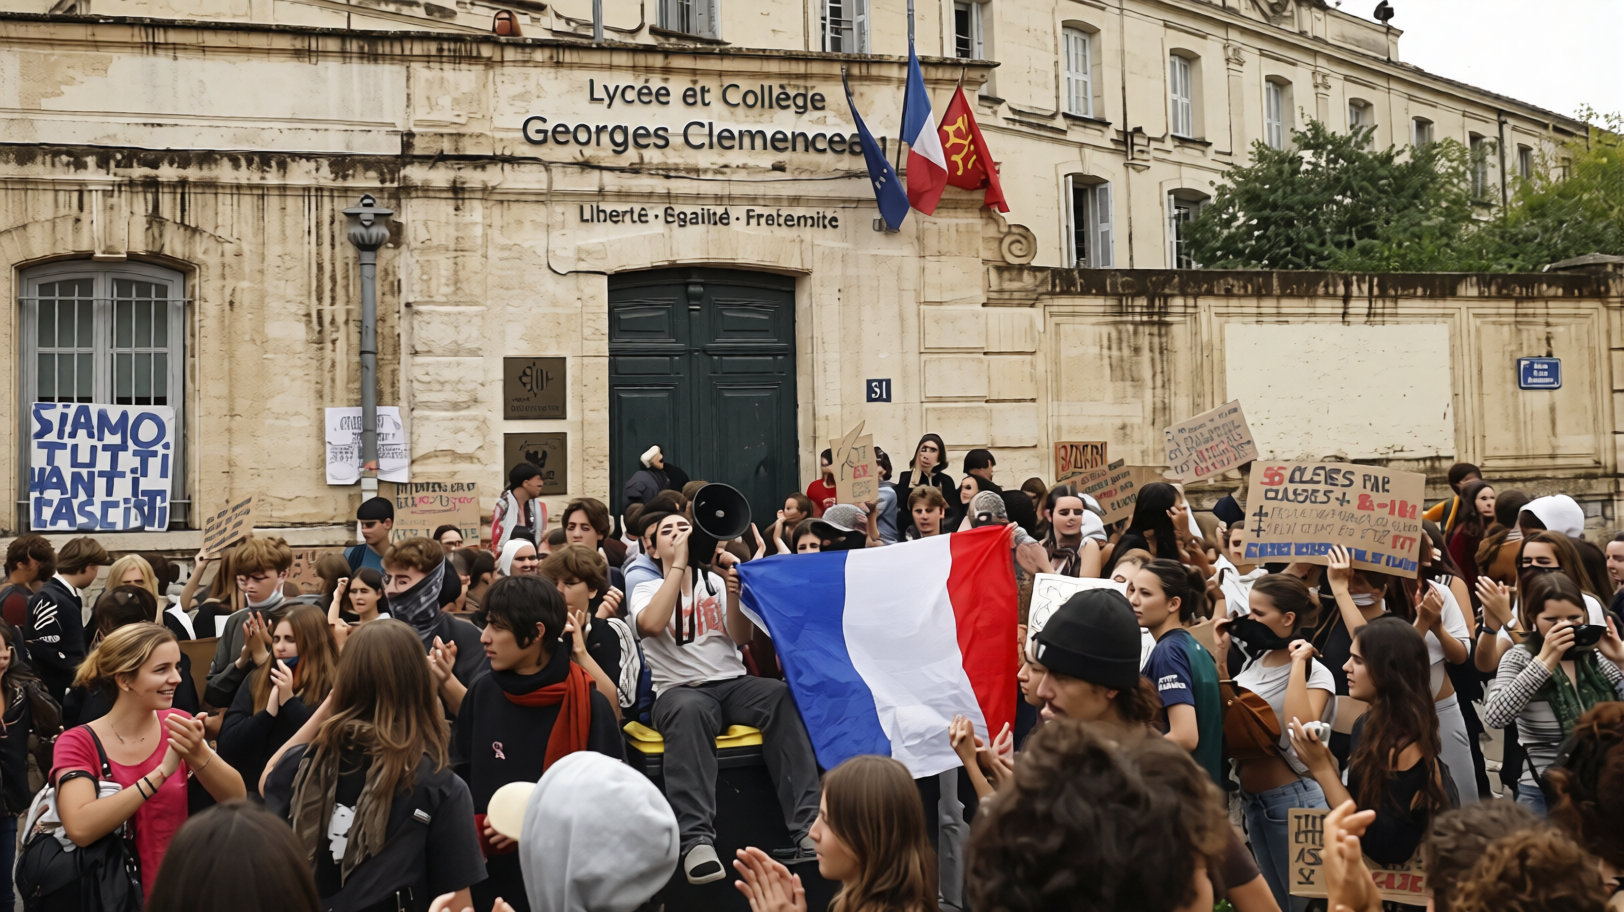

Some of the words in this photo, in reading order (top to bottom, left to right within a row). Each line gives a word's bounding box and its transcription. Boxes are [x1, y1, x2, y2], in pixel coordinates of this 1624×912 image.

[589, 78, 671, 109] Lycée
[682, 84, 710, 107] et
[722, 83, 826, 114] Collège
[522, 115, 669, 154] Georges
[682, 121, 887, 158] Clemencea
